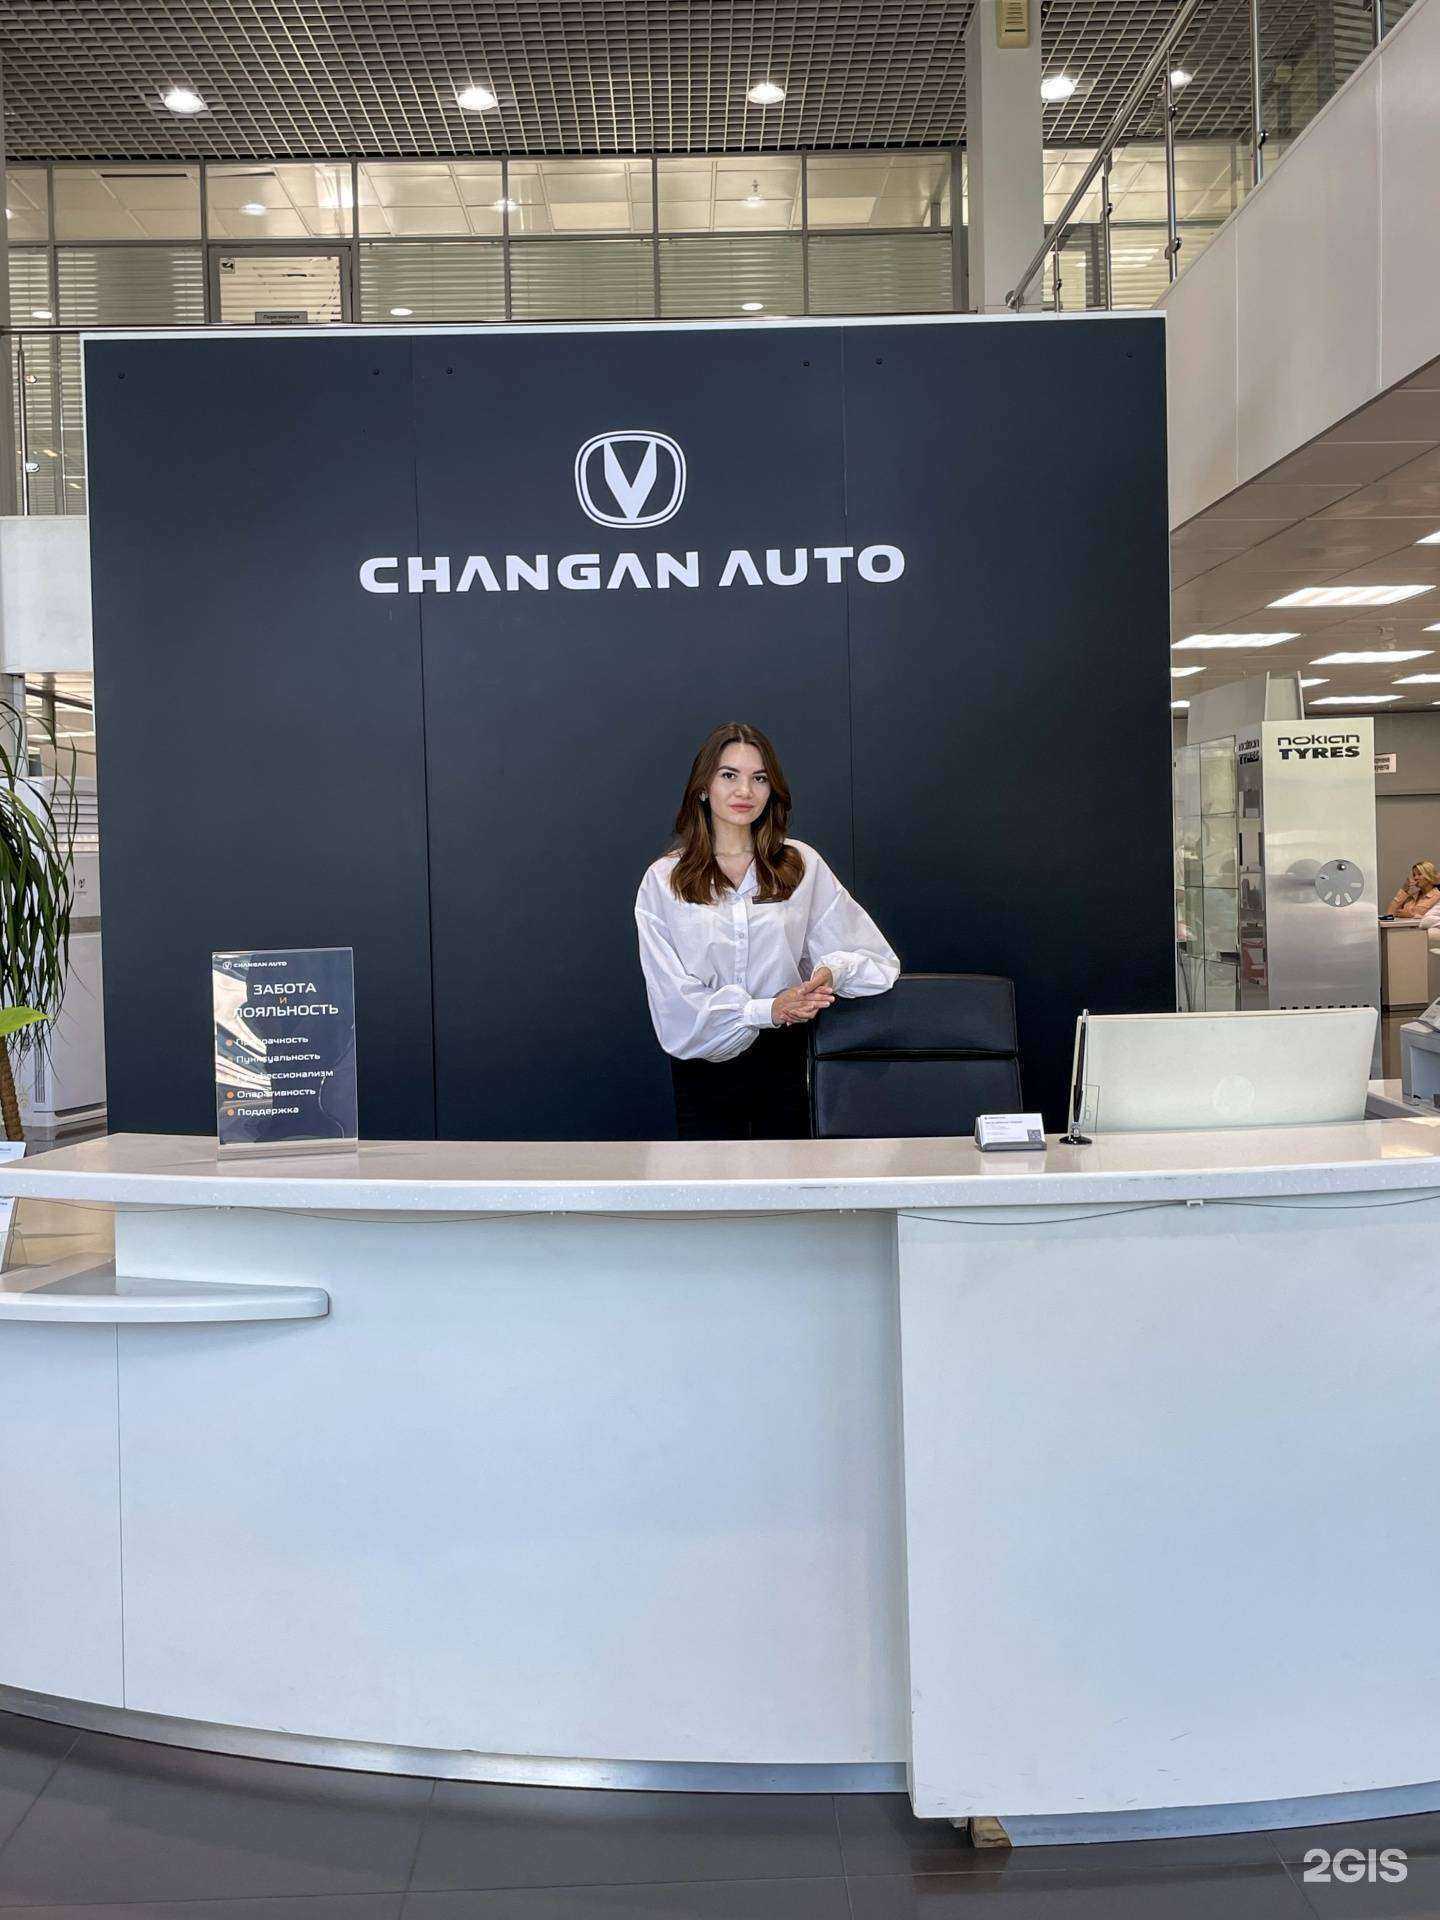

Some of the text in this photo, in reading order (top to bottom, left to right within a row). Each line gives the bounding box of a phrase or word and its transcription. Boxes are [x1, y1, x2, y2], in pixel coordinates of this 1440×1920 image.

[359, 544, 905, 594] CHANGAN AUTO
[1277, 734, 1360, 746] nokian
[1278, 746, 1360, 760] TYRES
[253, 983, 317, 995] ЗАБОТА
[237, 1106, 299, 1117] Поддержка
